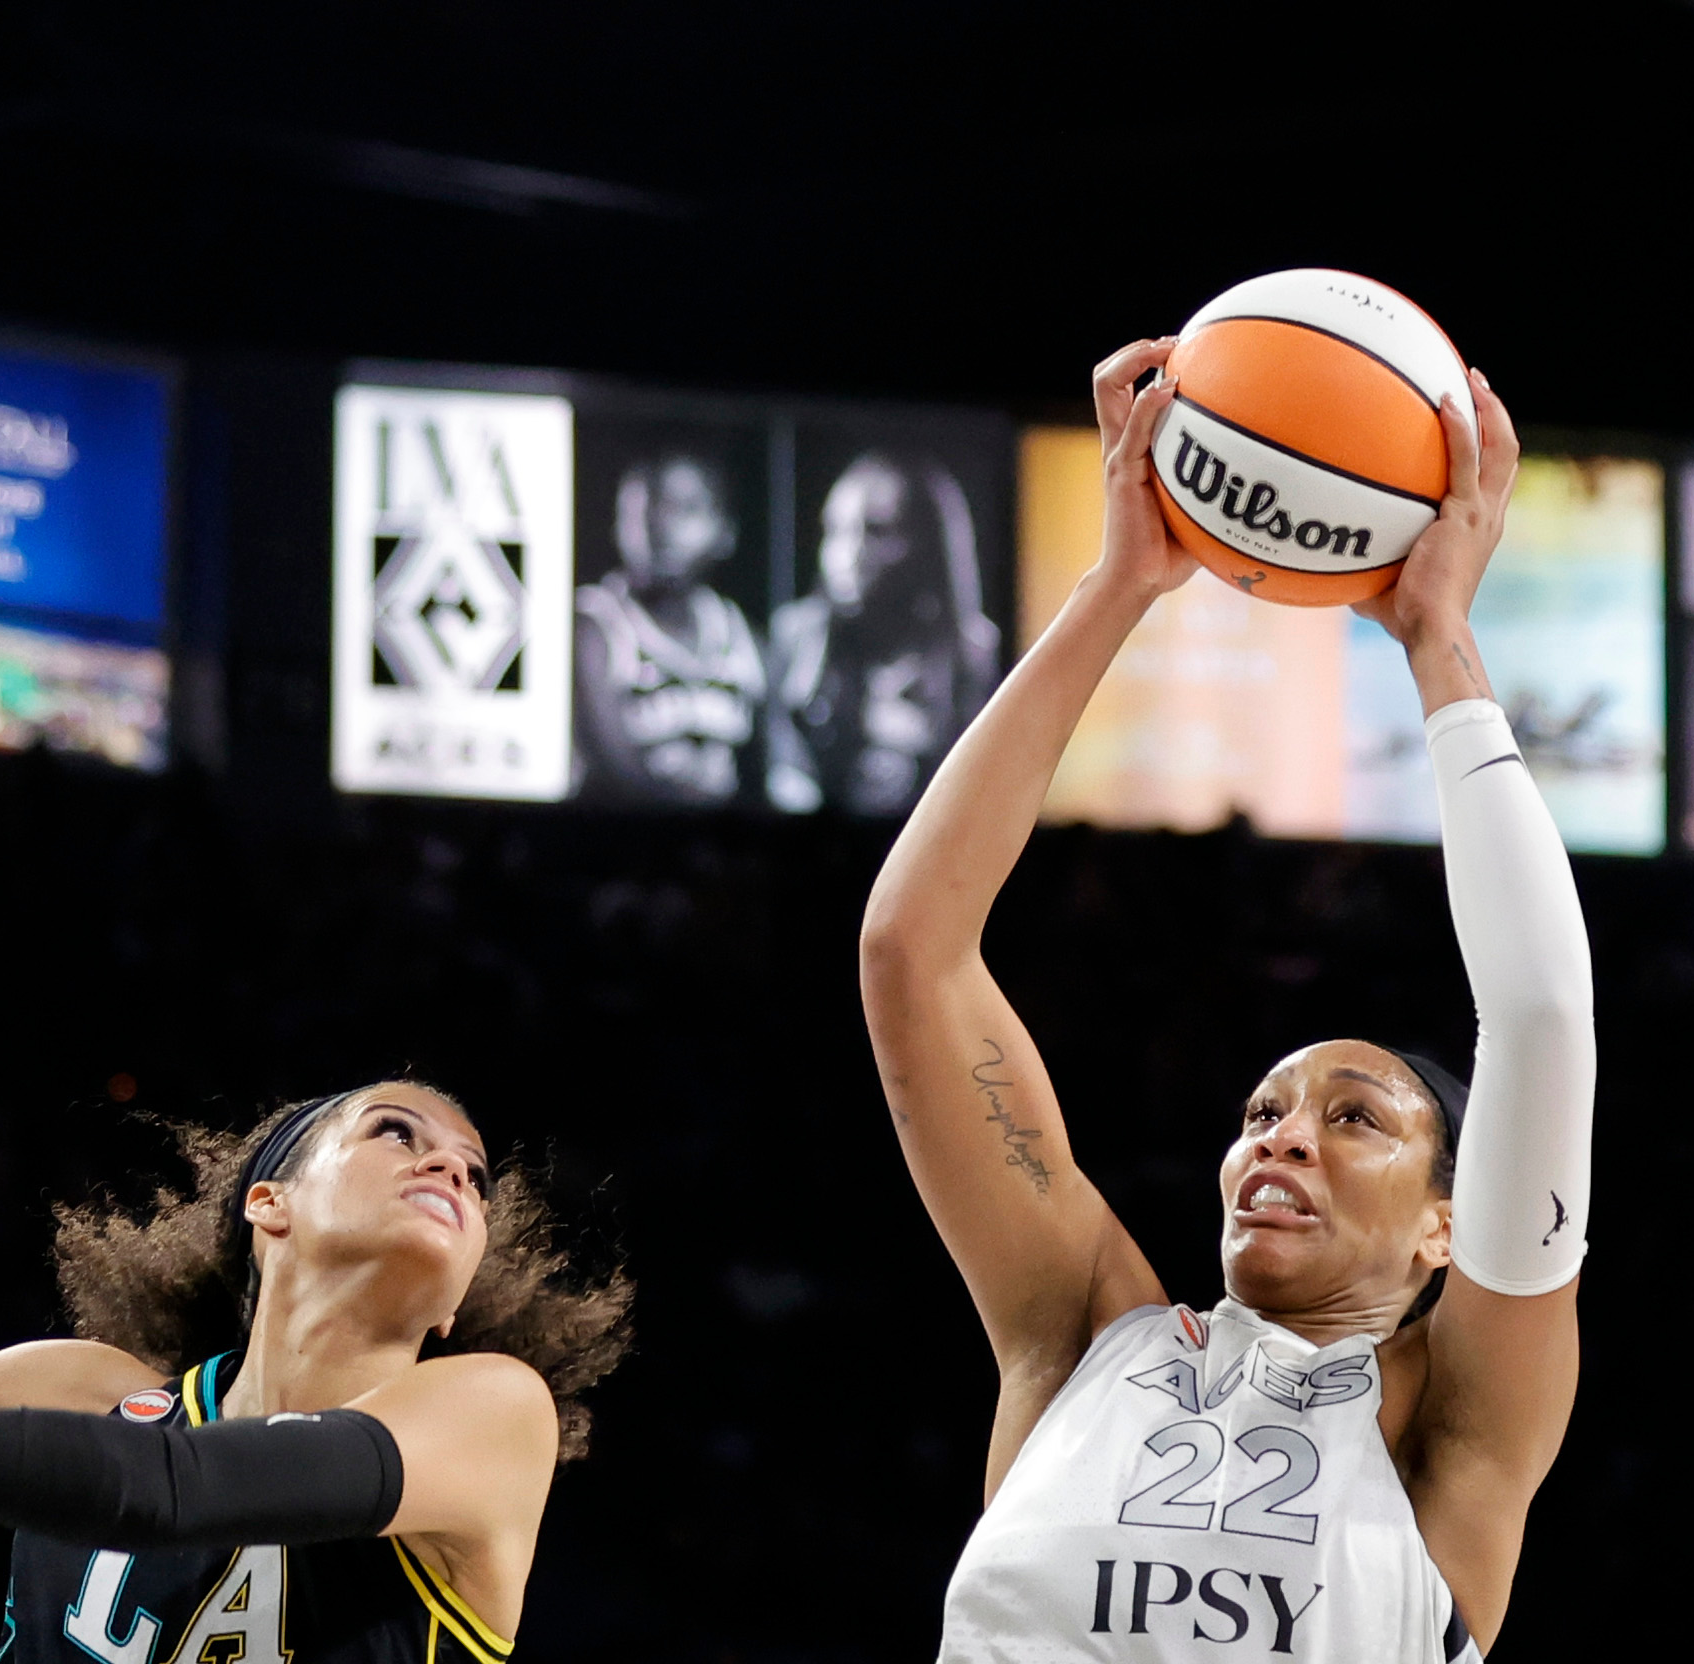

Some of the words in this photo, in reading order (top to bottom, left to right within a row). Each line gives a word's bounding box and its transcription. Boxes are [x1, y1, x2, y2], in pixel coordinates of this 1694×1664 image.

[1174, 425, 1374, 558] Wilson
[1125, 1340, 1374, 1414] ACES
[1118, 1421, 1320, 1545] 22
[1091, 1558, 1324, 1654] IPSY
